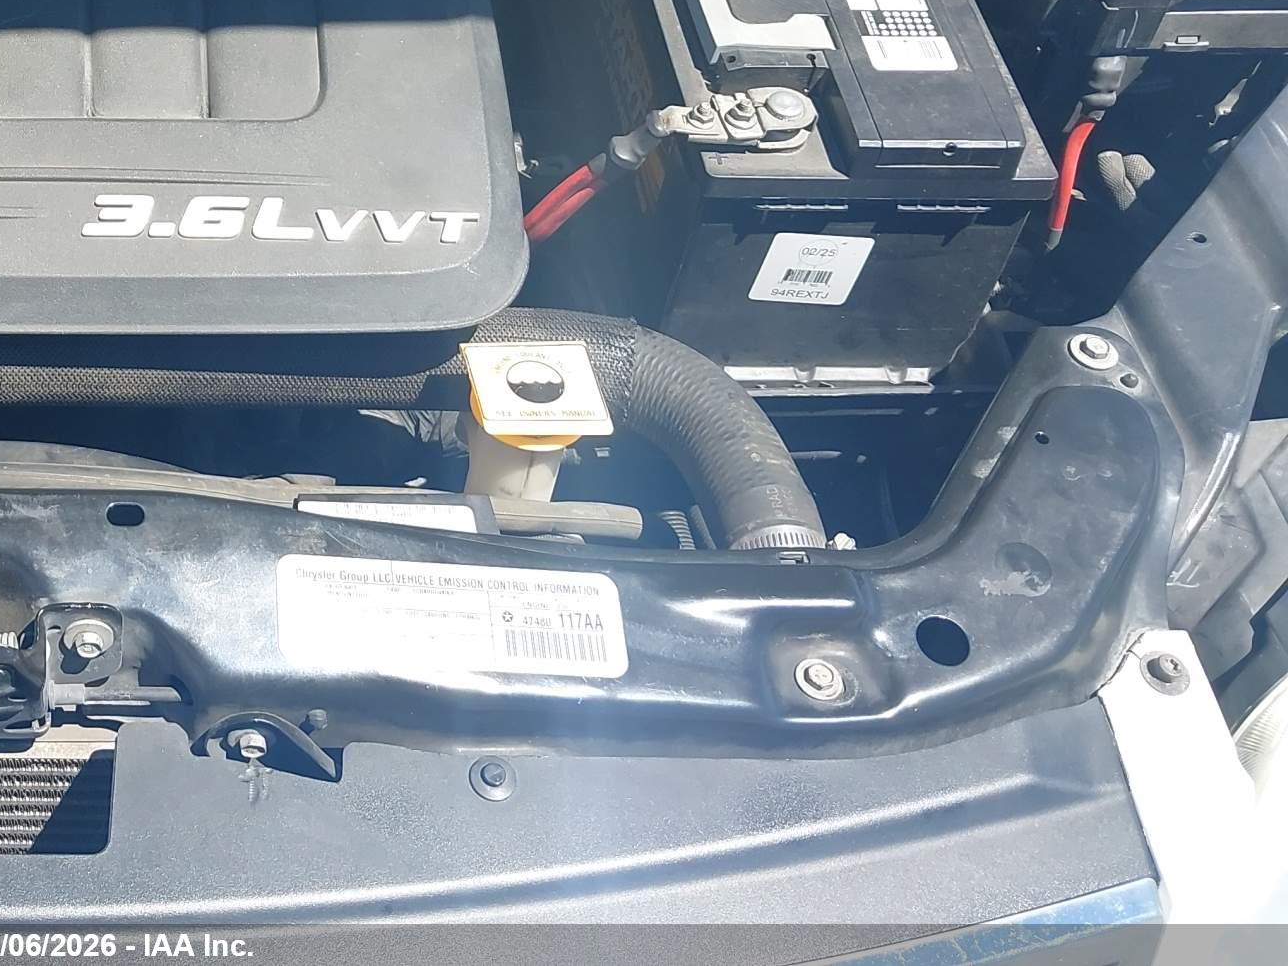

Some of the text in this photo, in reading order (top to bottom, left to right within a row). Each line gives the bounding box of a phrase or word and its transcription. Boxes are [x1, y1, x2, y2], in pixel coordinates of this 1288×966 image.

[801, 247, 837, 257] 02/25
[770, 288, 830, 299] 94REXTJ
[339, 570, 369, 584] Group
[372, 573, 391, 583] LLC
[395, 574, 434, 586] VEHICLE
[438, 576, 484, 589] EMISSION
[487, 579, 530, 592] CONTROL
[534, 583, 600, 596] INFORMATION
[558, 612, 604, 631] 117AA
